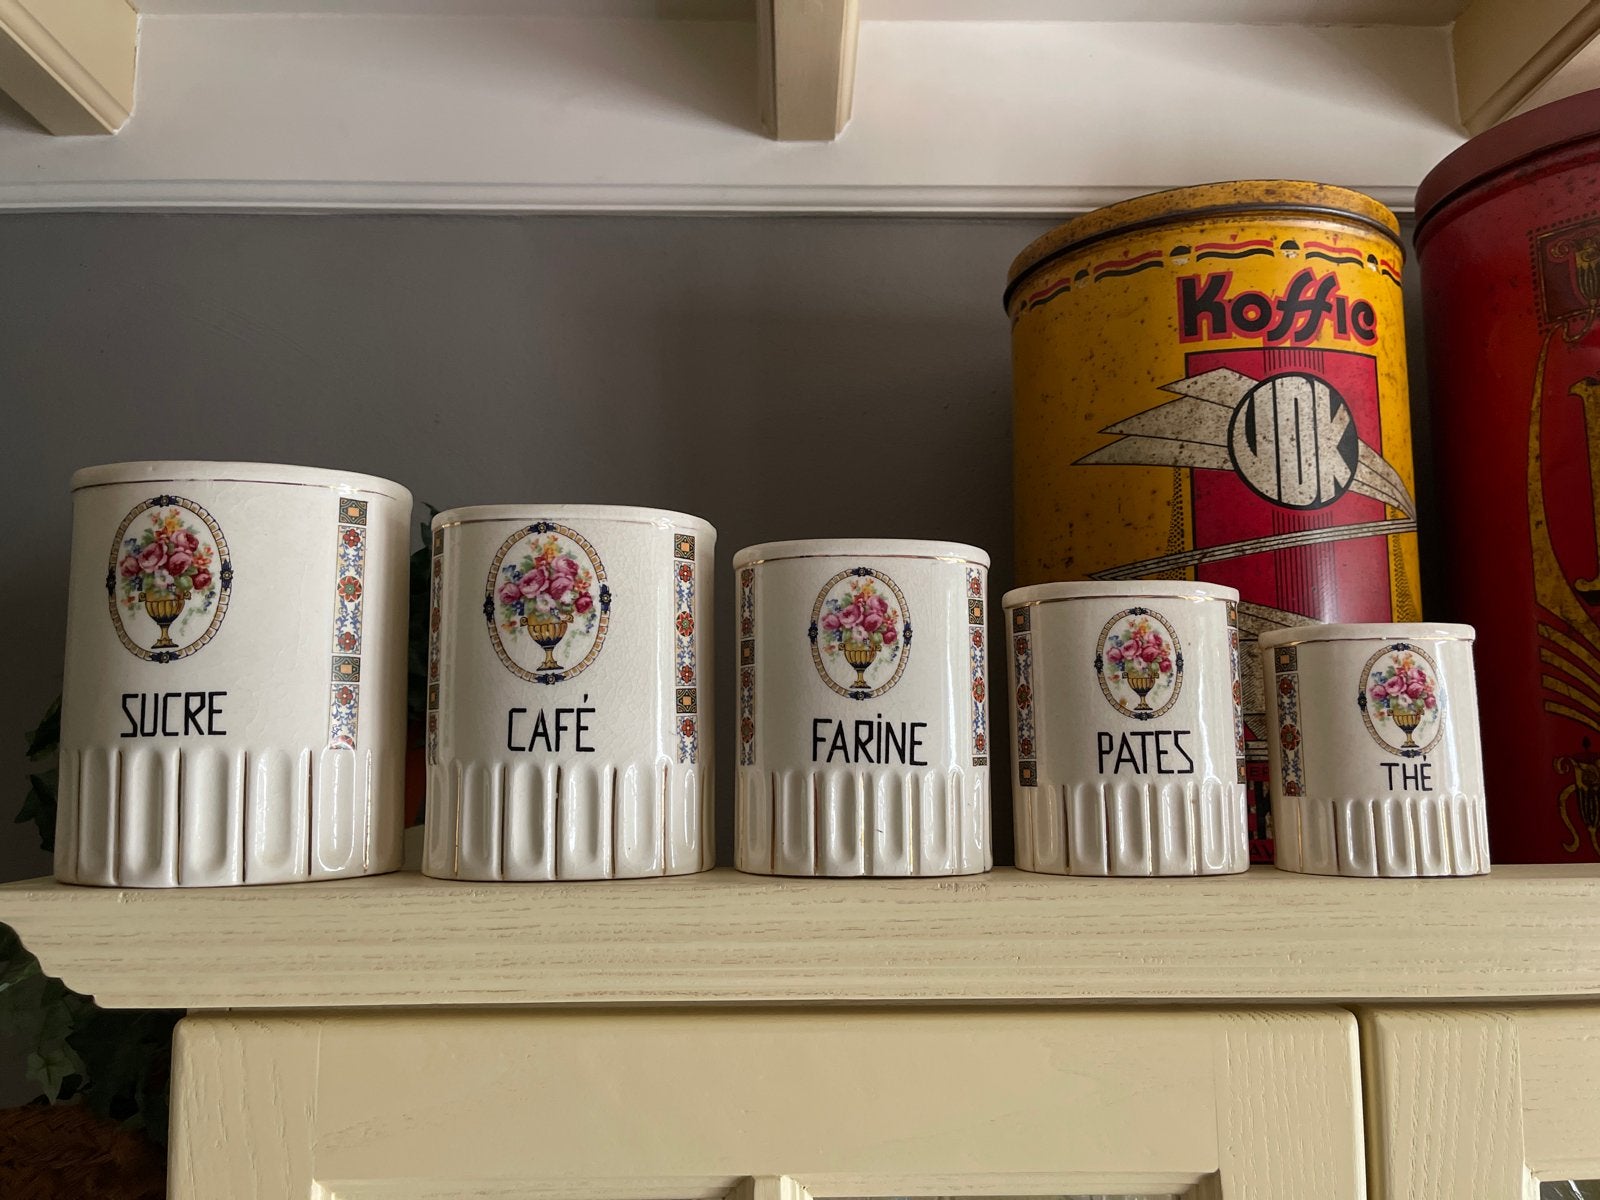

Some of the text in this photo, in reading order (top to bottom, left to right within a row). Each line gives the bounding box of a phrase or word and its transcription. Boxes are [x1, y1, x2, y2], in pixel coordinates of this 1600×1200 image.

[120, 691, 227, 738] SUCRE
[507, 693, 596, 752] CAFÉ
[1097, 730, 1194, 774] PATES
[1380, 754, 1433, 791] THÉ
